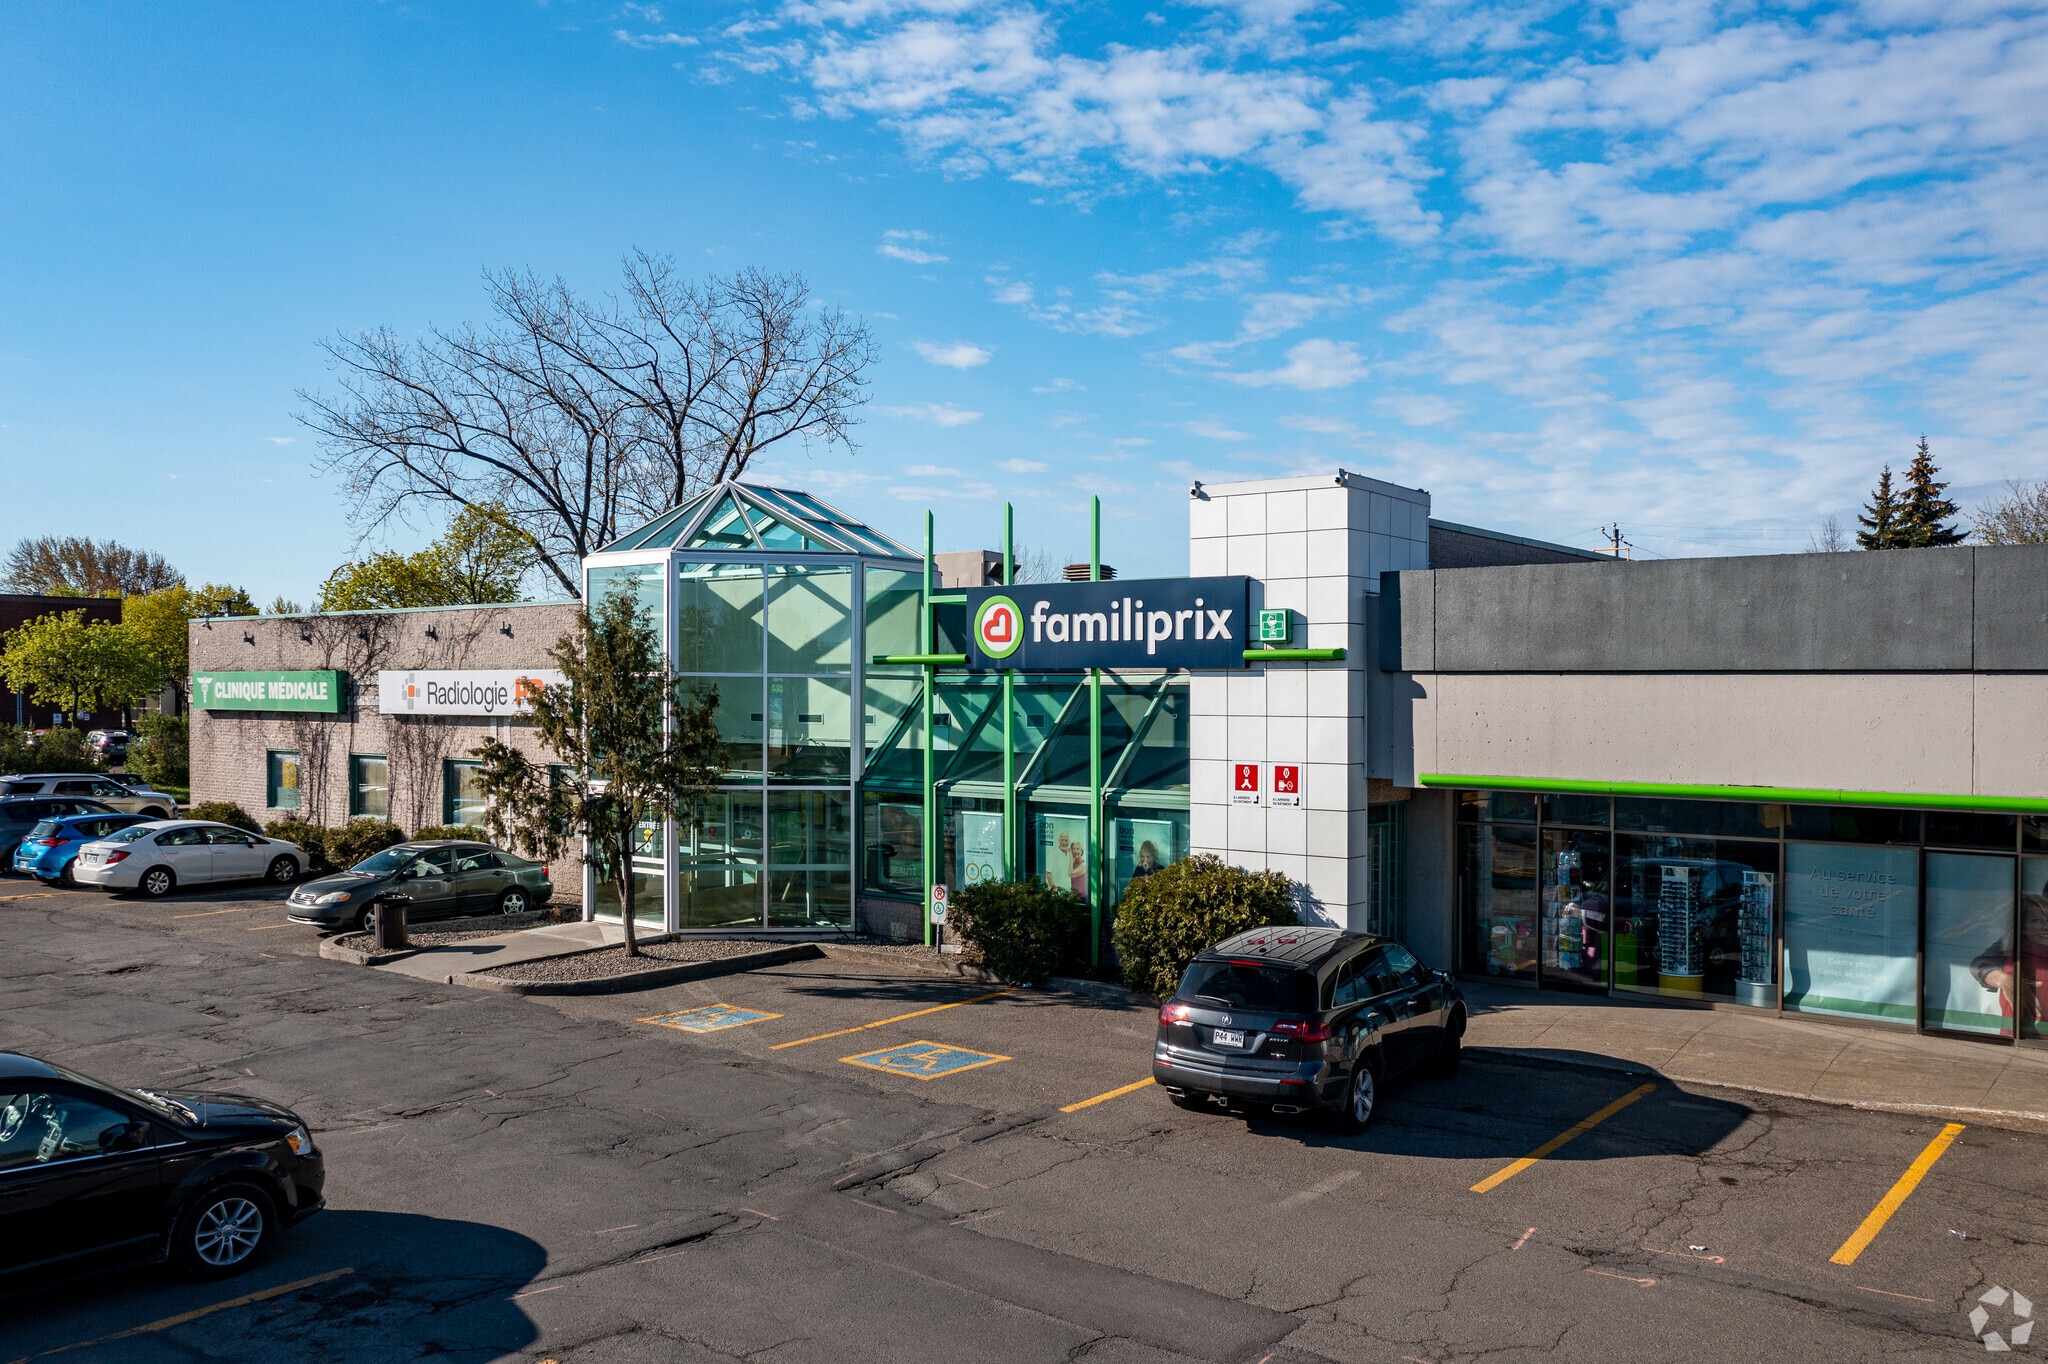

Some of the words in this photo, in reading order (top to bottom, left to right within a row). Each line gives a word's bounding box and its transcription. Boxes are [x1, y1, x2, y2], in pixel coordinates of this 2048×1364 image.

[1030, 597, 1233, 655] familiprix
[214, 681, 265, 701] CLINIQUE
[268, 676, 328, 700] MÉDICALE
[427, 681, 508, 713] Radiologie
[1119, 825, 1134, 835] bon
[890, 866, 917, 876] BEAUTÉ
[1810, 866, 1832, 880] Au
[1837, 869, 1897, 885] service
[1821, 884, 1840, 898] de
[1844, 888, 1886, 902] votre
[1830, 905, 1876, 919] santé
